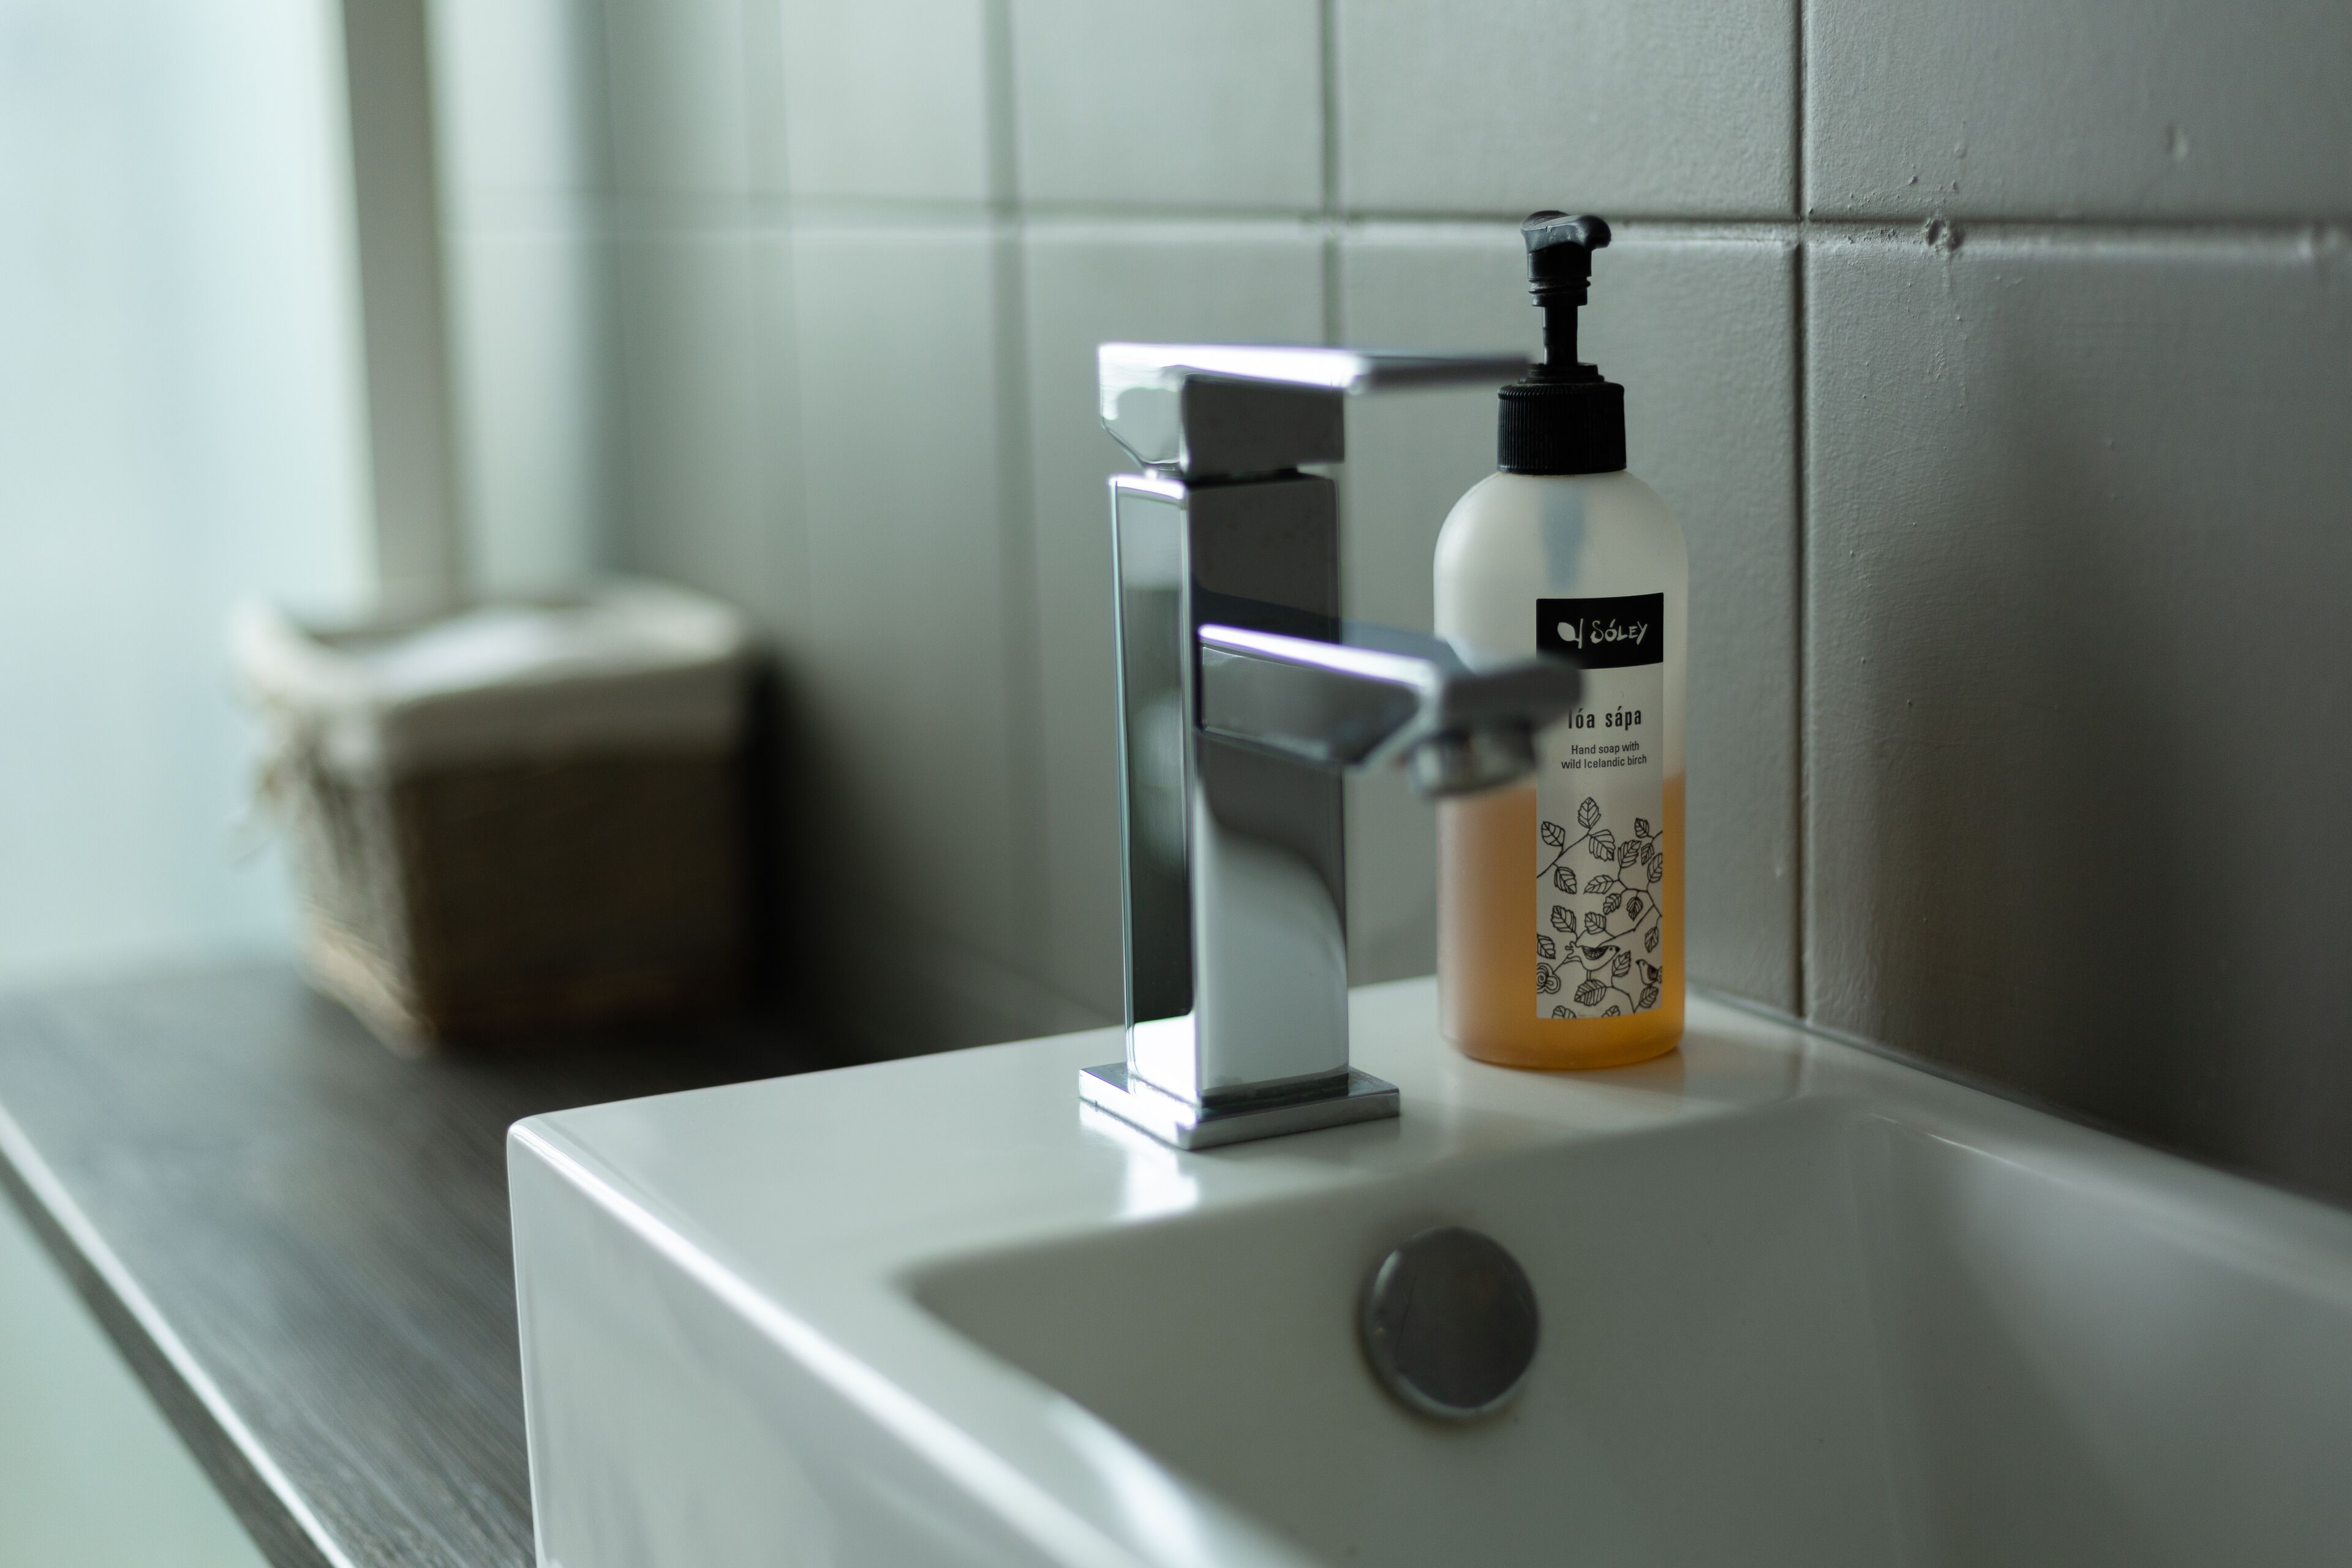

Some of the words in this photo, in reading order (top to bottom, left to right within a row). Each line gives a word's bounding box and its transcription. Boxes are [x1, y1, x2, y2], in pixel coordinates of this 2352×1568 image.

[1605, 706, 1642, 731] sápa
[1571, 744, 1596, 755] Hand
[1598, 745, 1619, 755] soap
[1621, 741, 1640, 752] with
[1561, 759, 1581, 769] wild
[1584, 756, 1625, 768] Icelandic
[1627, 754, 1647, 766] birch
